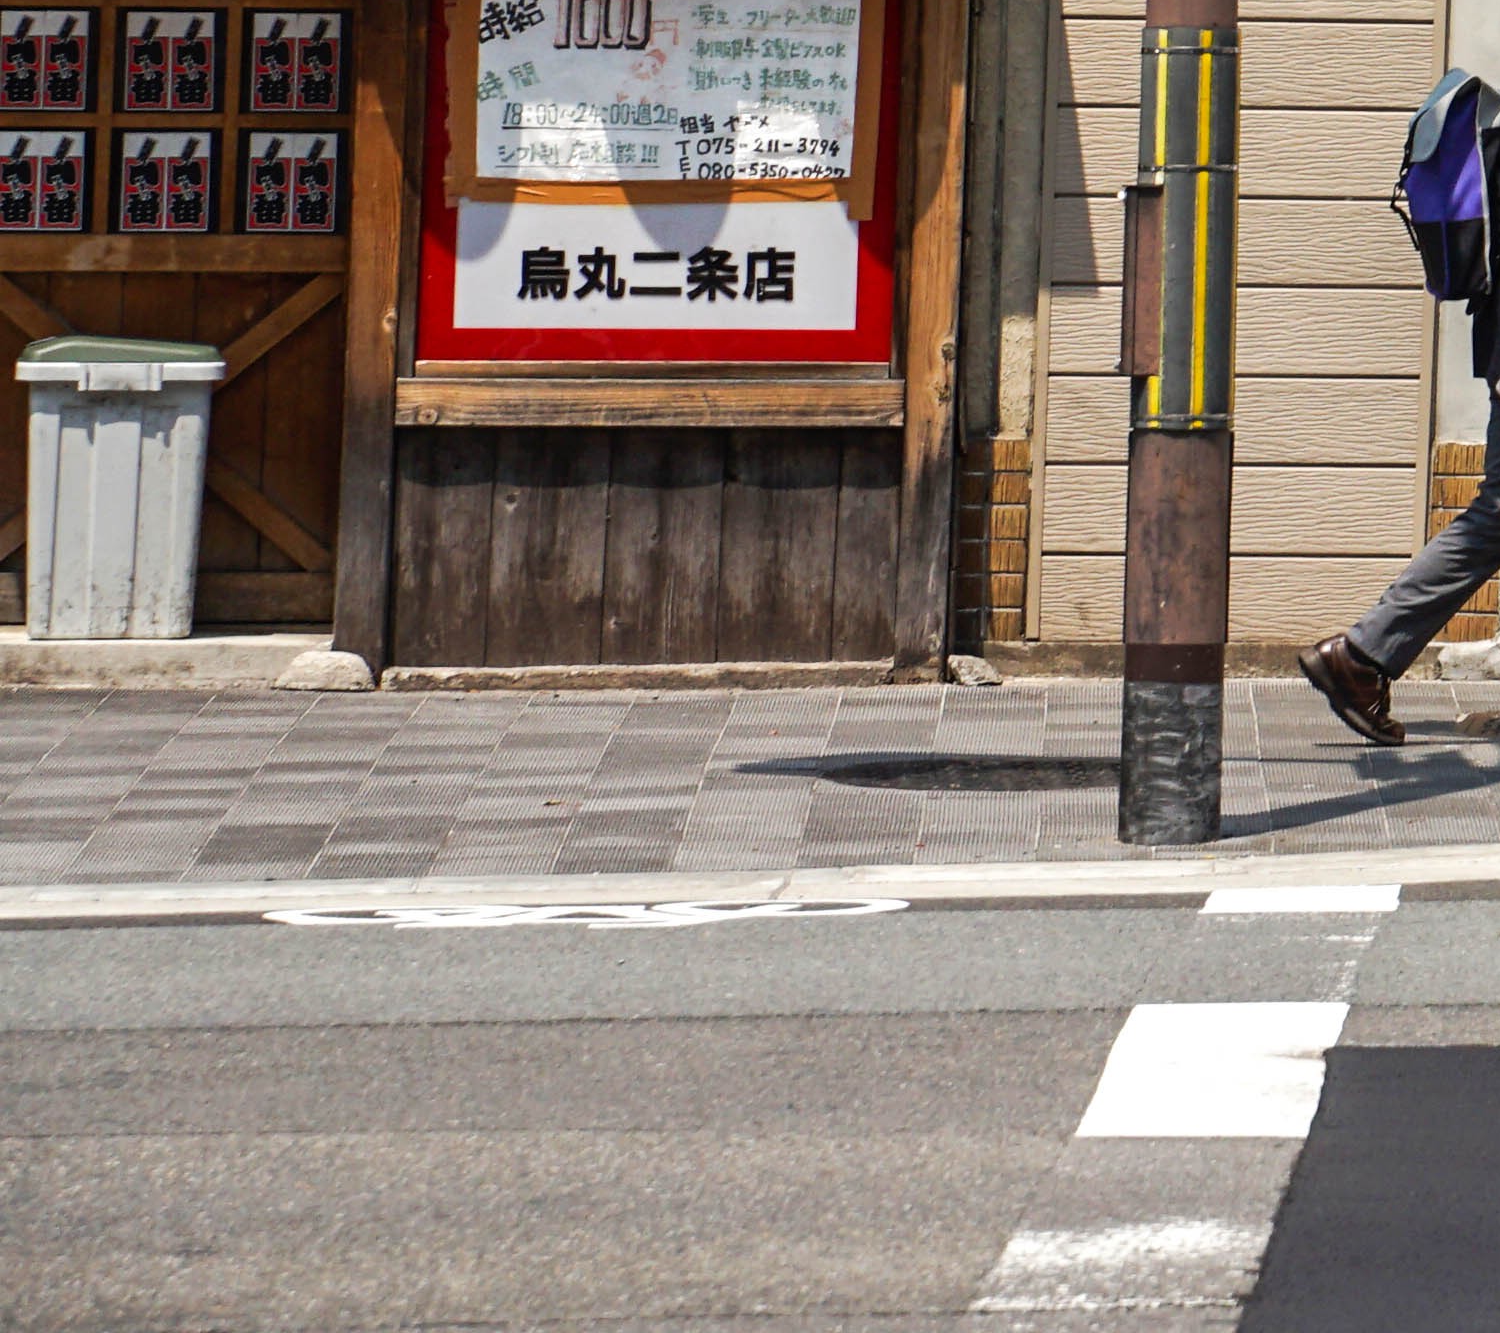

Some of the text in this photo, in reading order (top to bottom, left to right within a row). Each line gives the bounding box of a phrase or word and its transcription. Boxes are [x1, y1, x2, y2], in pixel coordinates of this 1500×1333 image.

[680, 114, 715, 134] 担当
[696, 137, 841, 157] 075-211-3794
[516, 246, 797, 302] 烏丸二条店
